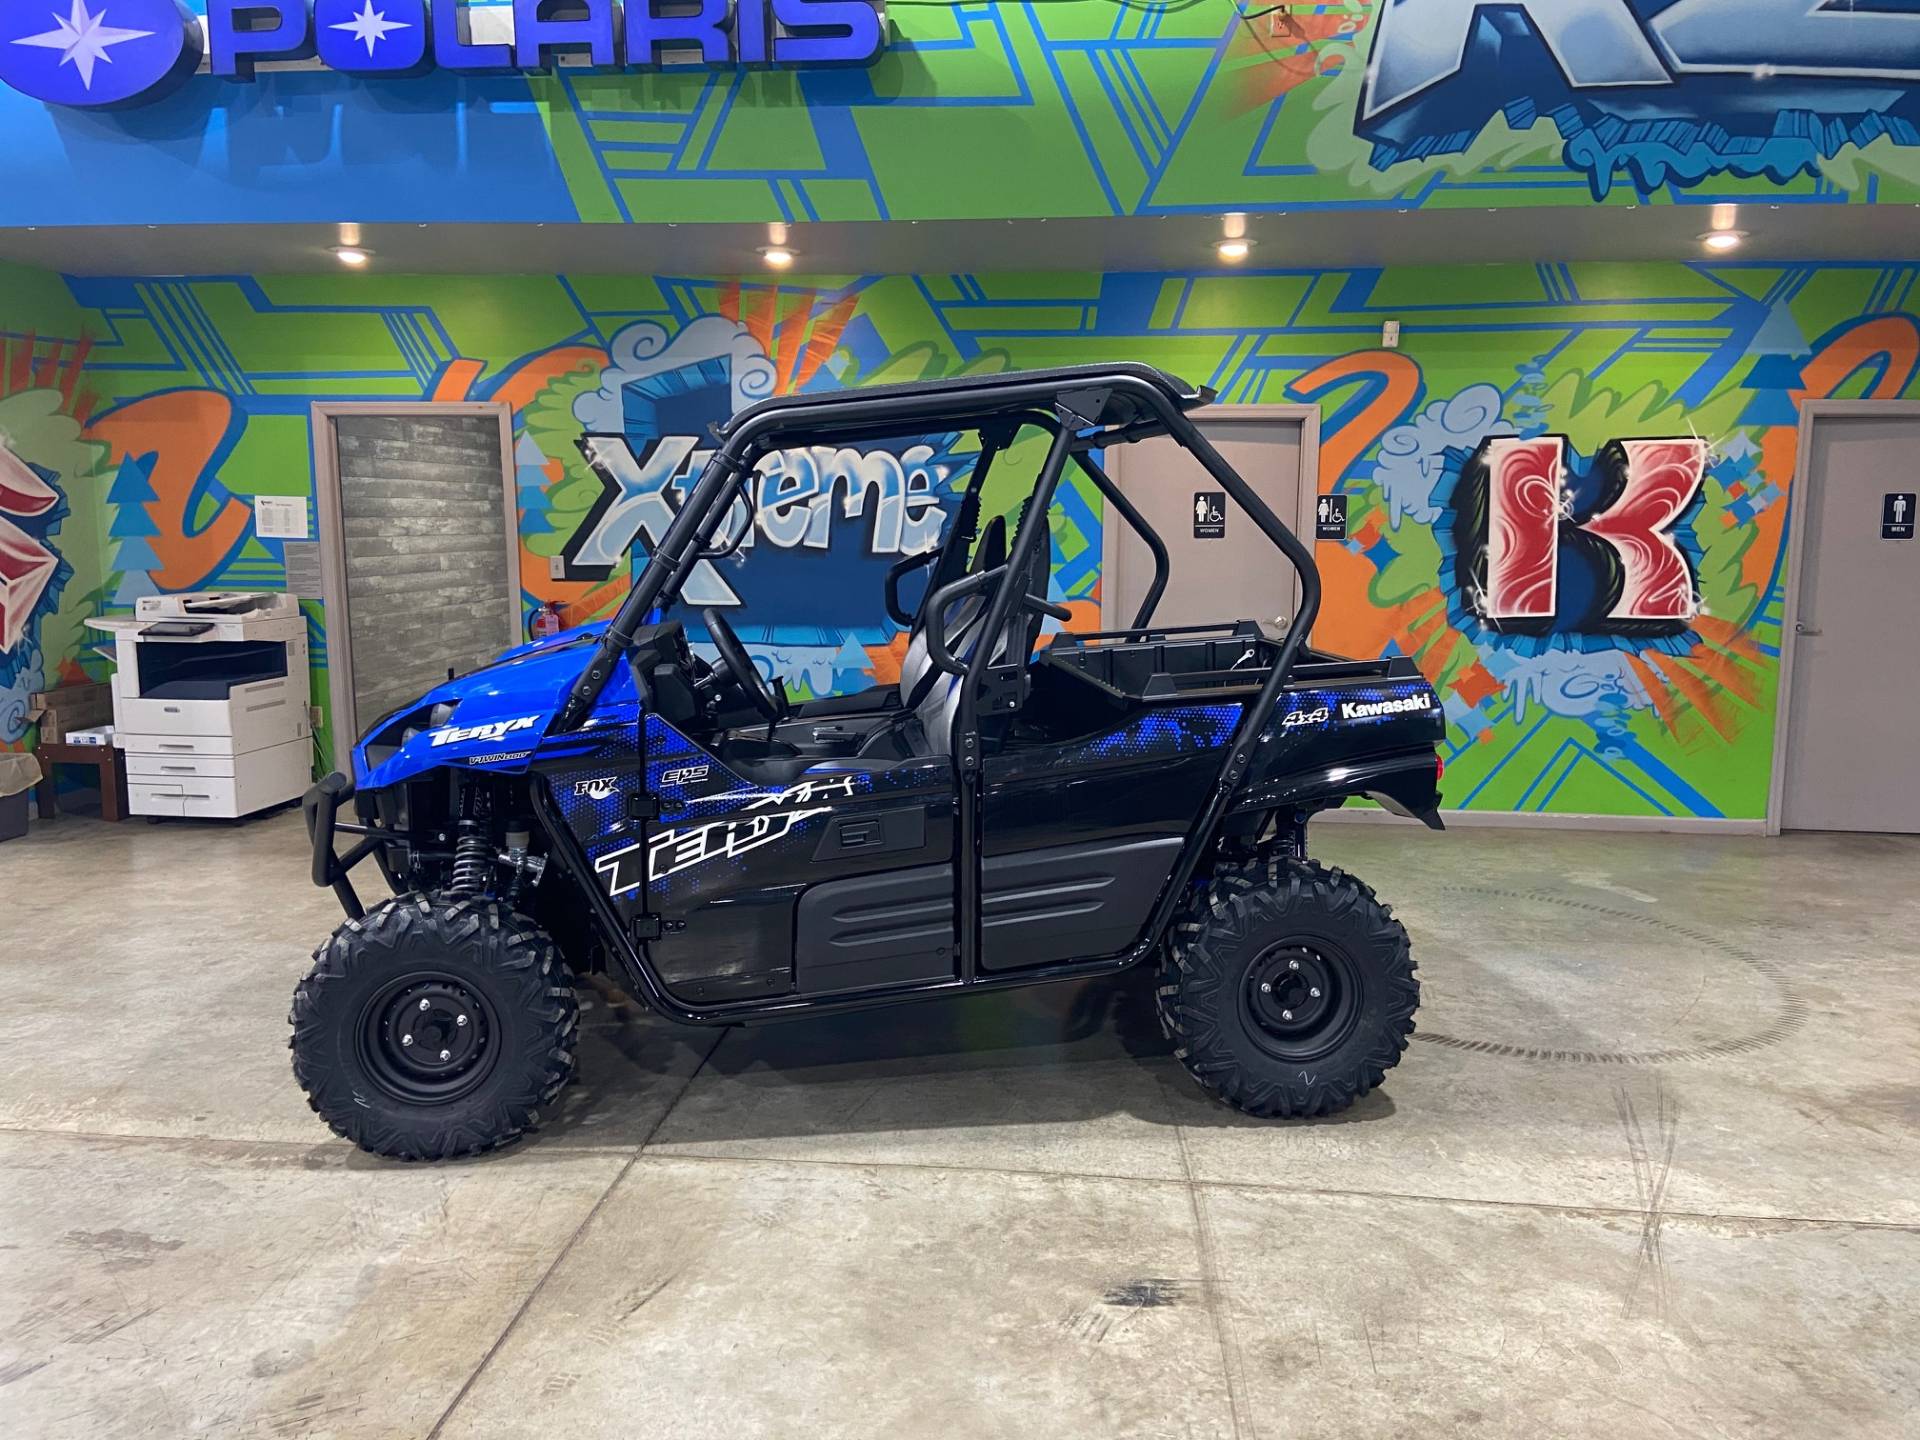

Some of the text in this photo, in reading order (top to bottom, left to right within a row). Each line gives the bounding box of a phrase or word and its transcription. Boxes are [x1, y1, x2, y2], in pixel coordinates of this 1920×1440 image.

[210, 0, 881, 77] POLARIS
[572, 436, 947, 605] Xteme
[1487, 437, 1706, 619] K
[1281, 707, 1329, 726] 4x4
[1341, 692, 1431, 719] Kawasaki
[574, 775, 620, 800] FOX
[661, 764, 709, 784] EPS
